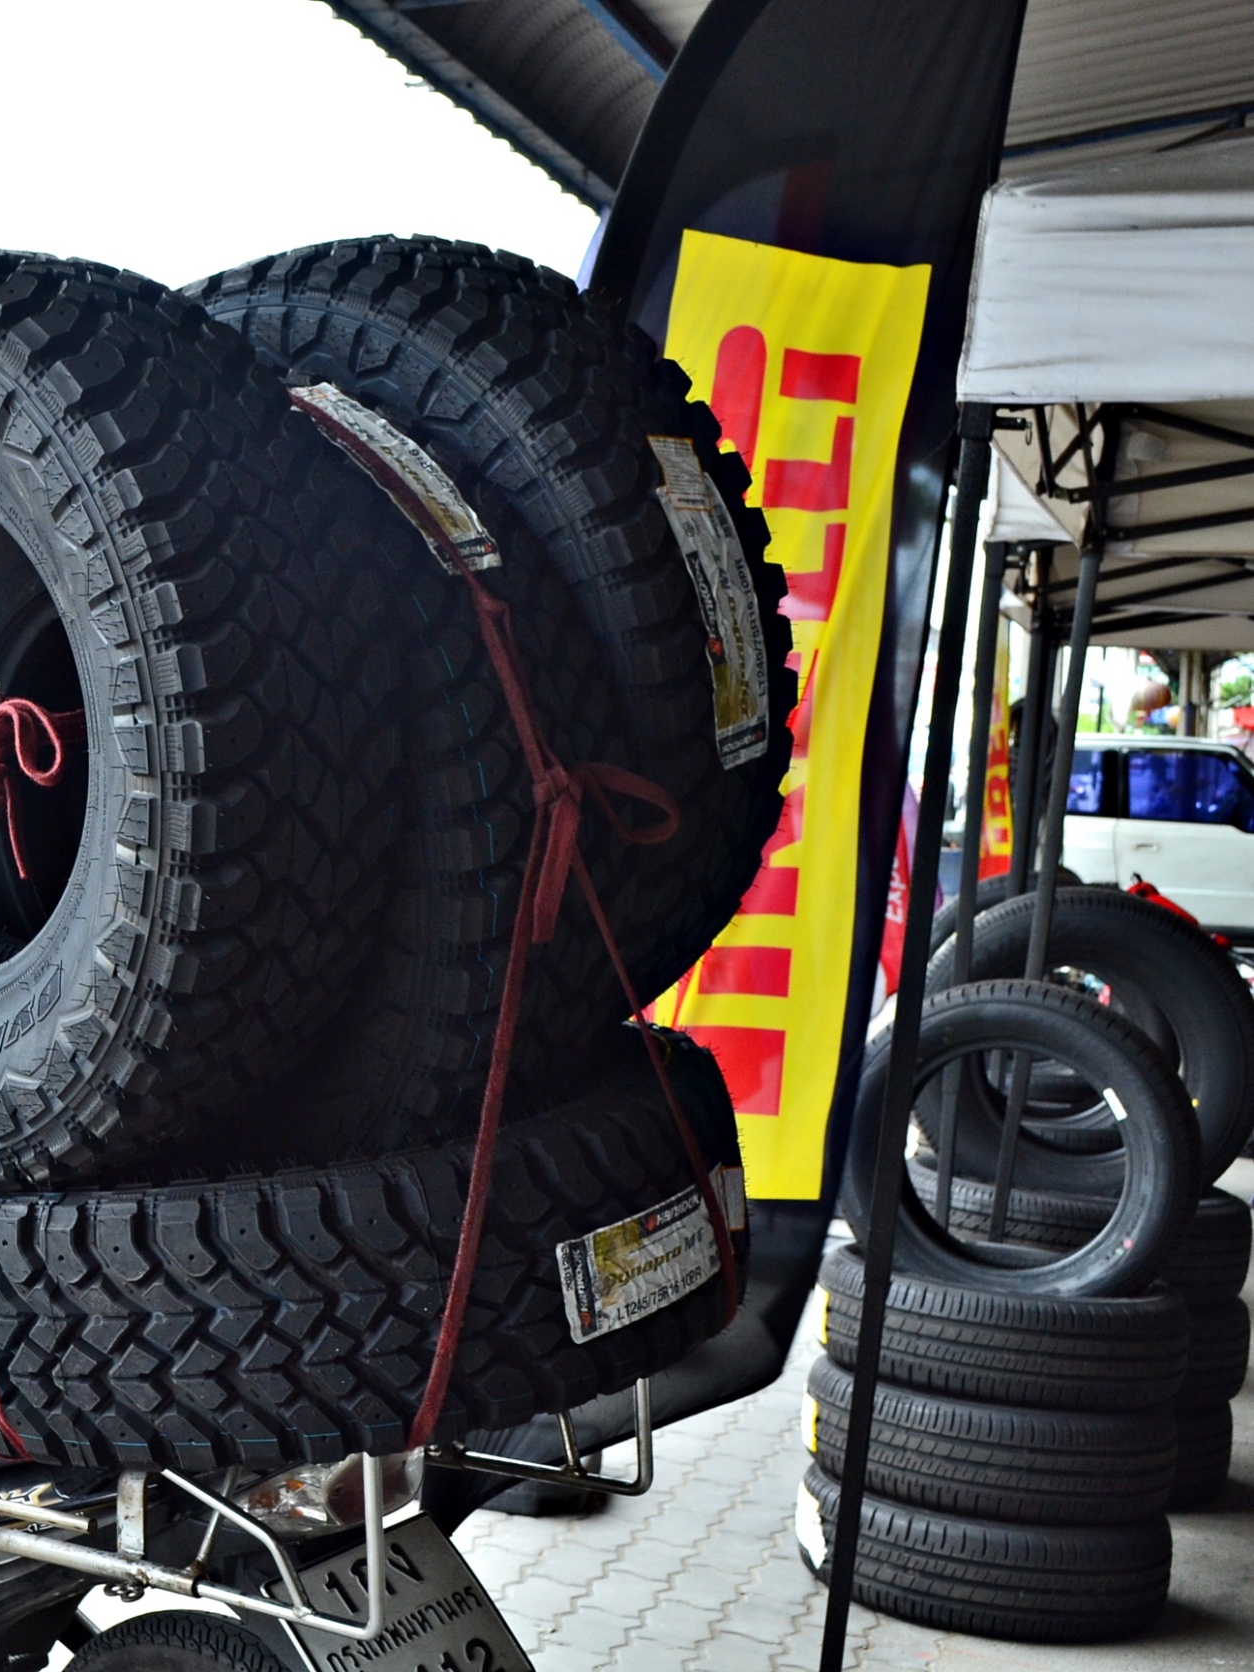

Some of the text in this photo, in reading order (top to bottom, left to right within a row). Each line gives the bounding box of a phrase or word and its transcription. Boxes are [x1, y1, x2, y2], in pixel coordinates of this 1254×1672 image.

[616, 1266, 702, 1321] LT245/75R16 10PR
[326, 1585, 483, 1672] กรงเทพมหานคร
